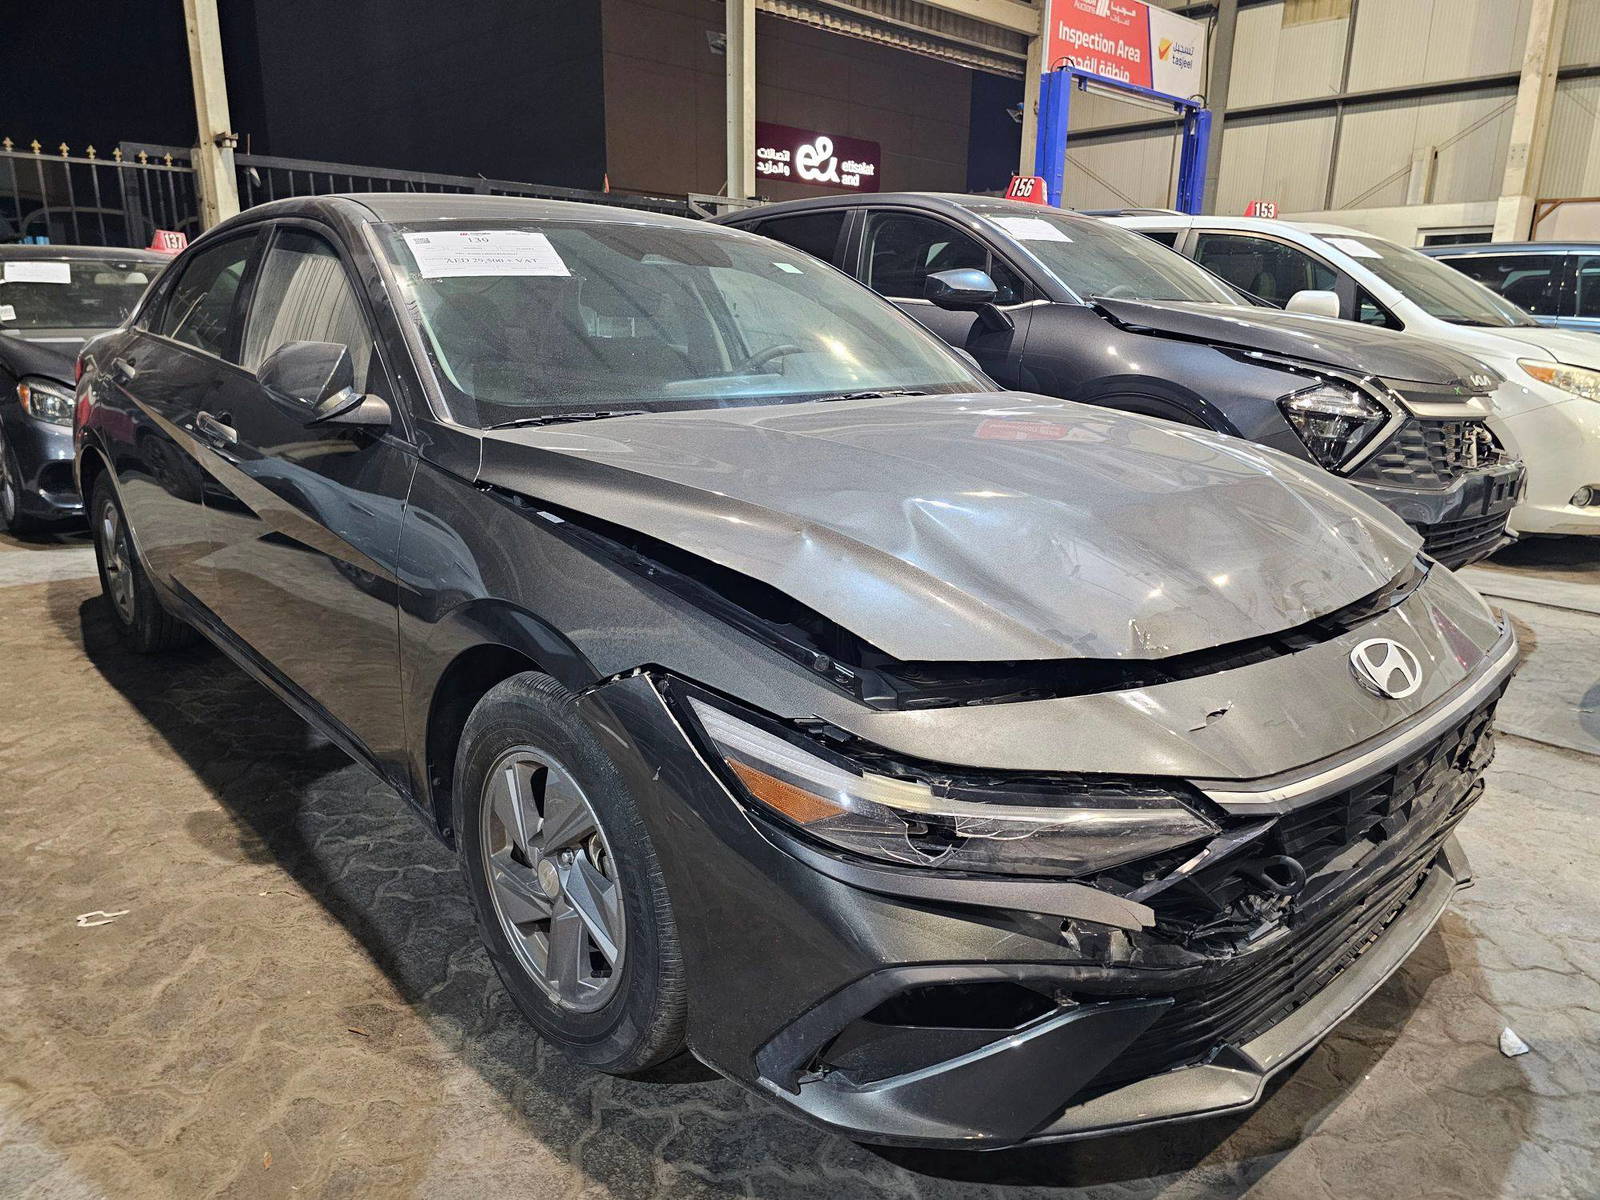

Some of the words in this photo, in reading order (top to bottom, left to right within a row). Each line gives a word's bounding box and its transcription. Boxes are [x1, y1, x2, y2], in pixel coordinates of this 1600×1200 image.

[1058, 20, 1115, 54] Inspection
[1117, 40, 1141, 63] Area
[1172, 55, 1193, 70] tasjeel
[841, 160, 875, 175] etisalat
[841, 174, 860, 187] and
[1011, 178, 1035, 198] 156
[1254, 202, 1275, 218] 153
[164, 232, 183, 249] 137
